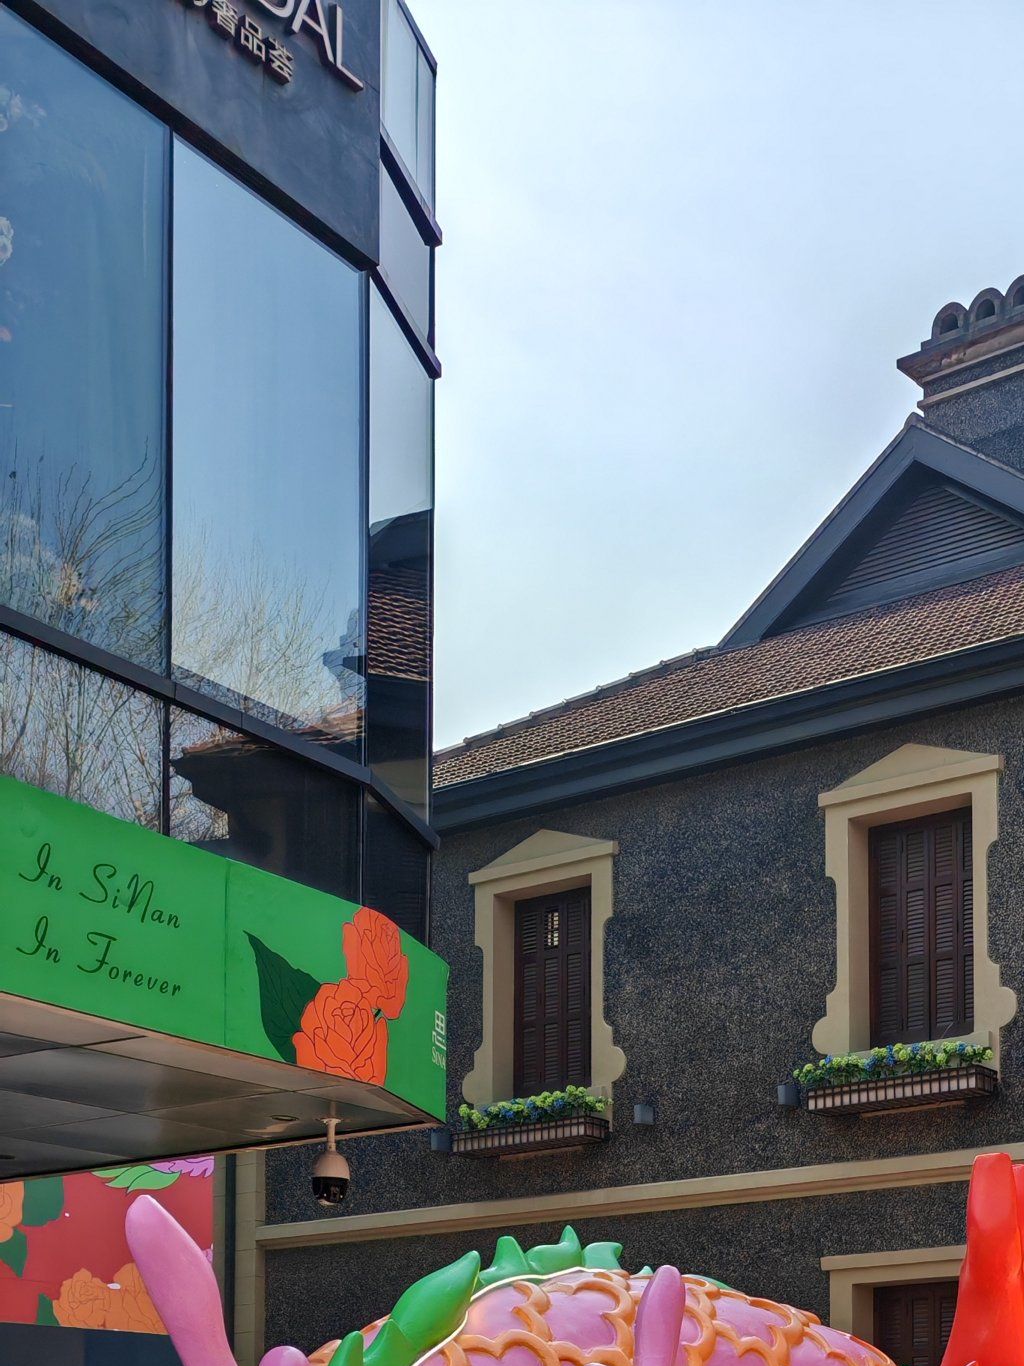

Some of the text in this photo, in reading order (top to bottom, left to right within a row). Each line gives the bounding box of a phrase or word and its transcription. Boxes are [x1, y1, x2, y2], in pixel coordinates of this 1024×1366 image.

[196, 0, 294, 83] 奢品荟
[260, 0, 363, 90] AL
[19, 843, 62, 891] In
[16, 916, 181, 996] In Forever
